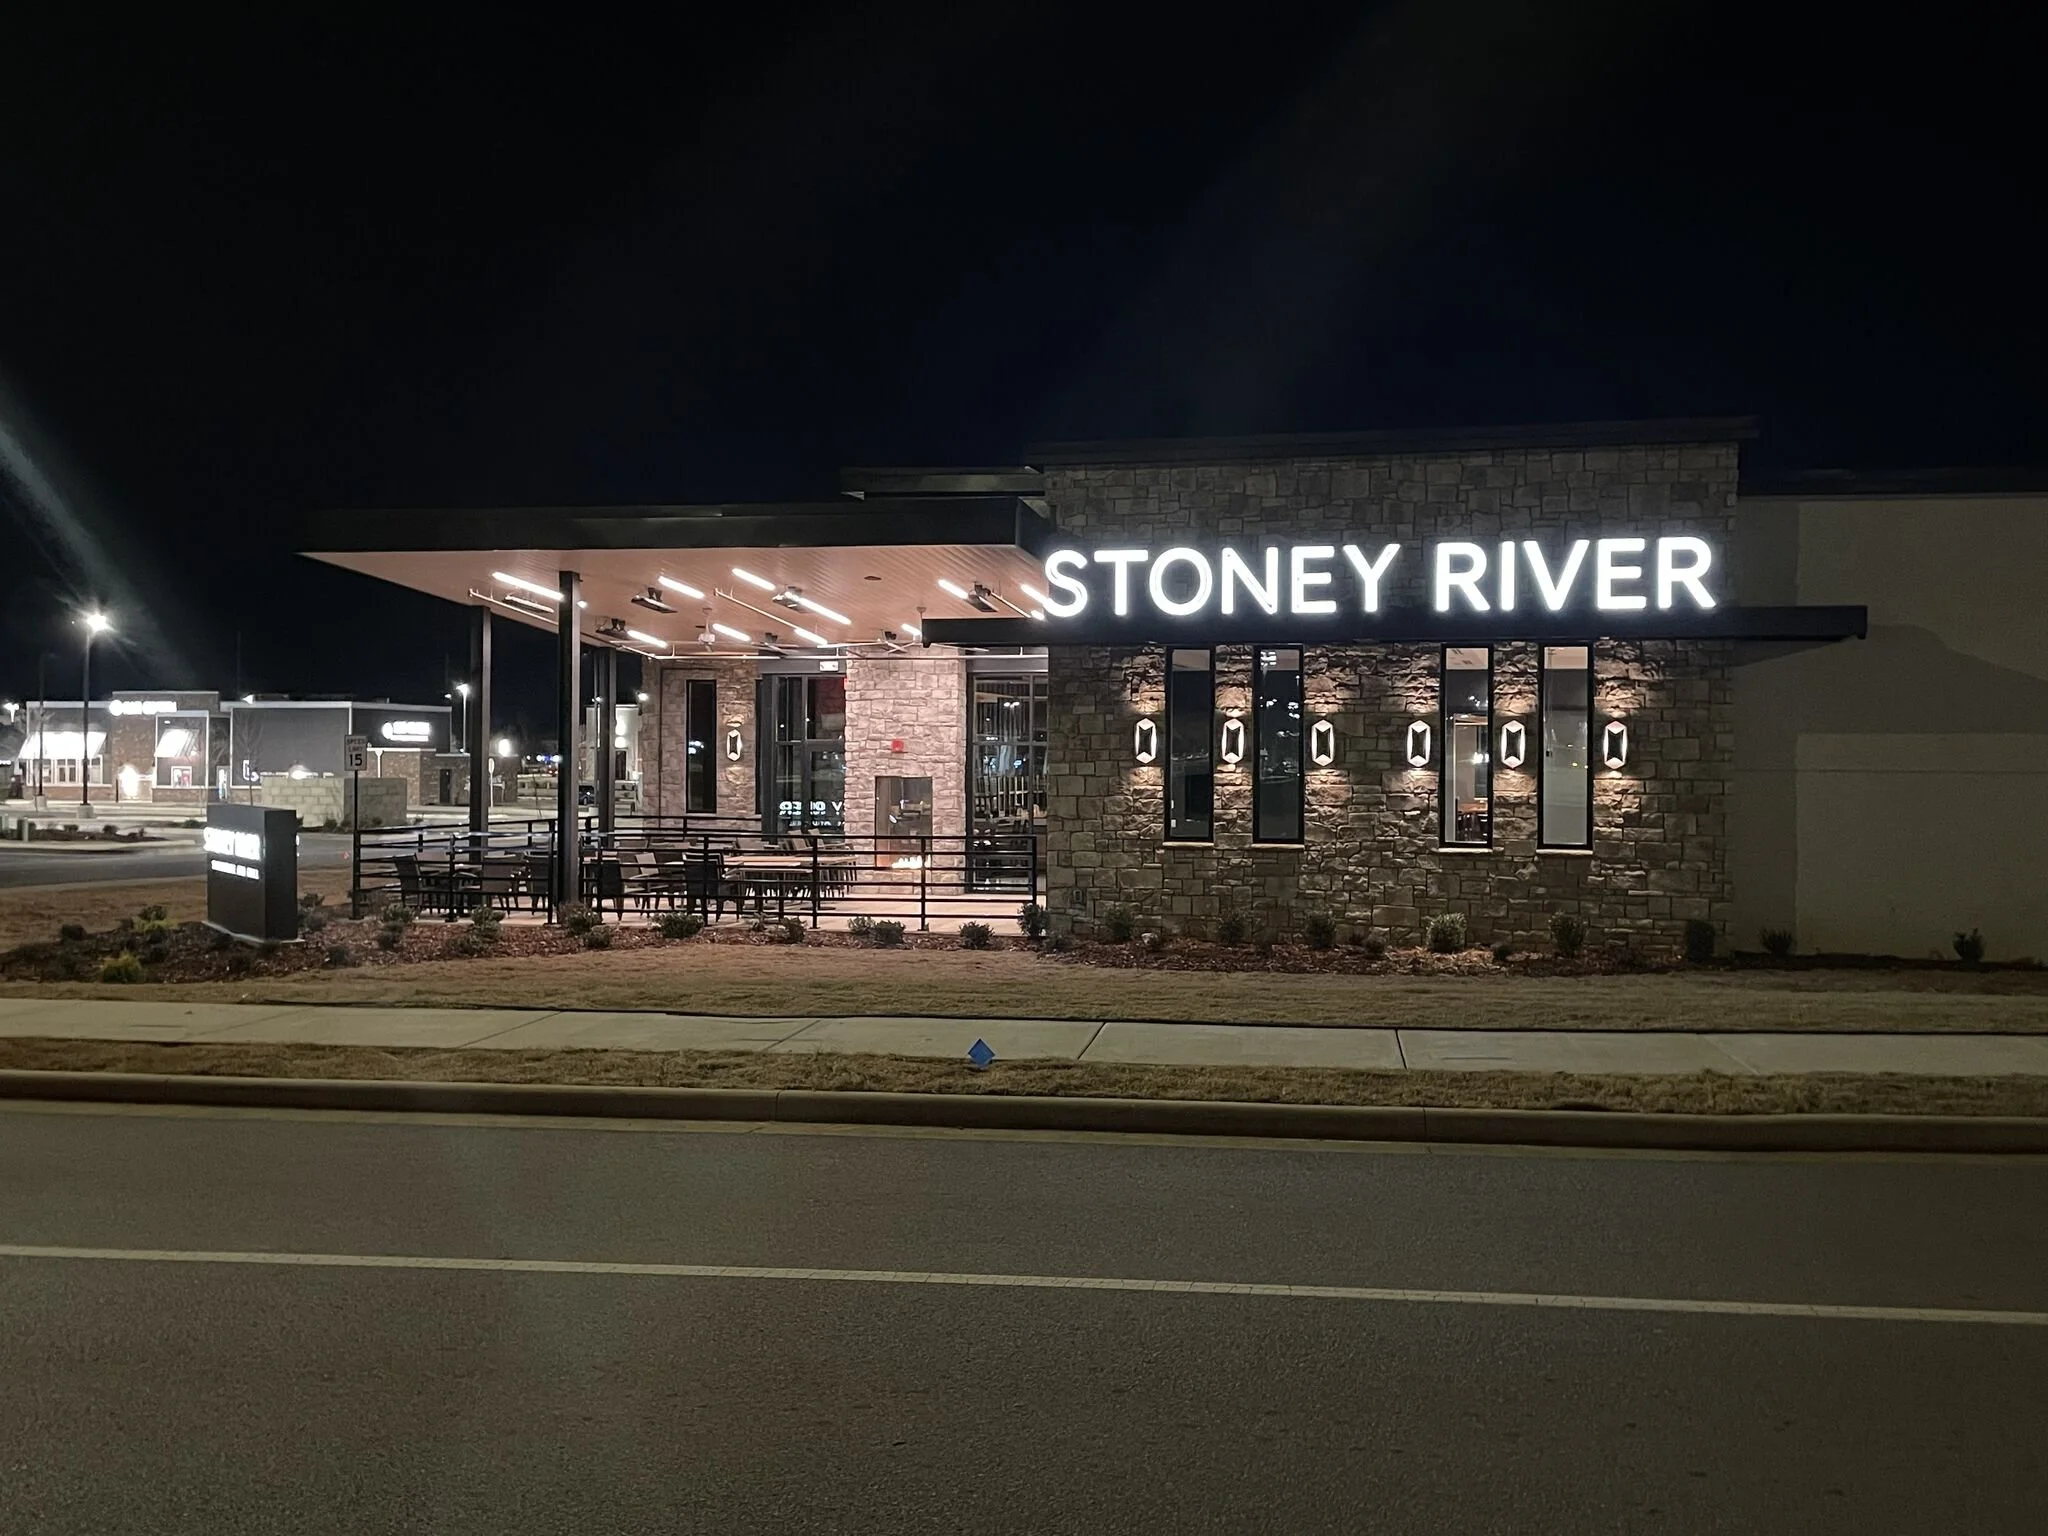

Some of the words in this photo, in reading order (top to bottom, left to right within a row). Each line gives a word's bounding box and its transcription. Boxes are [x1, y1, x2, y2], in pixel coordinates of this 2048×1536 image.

[1044, 543, 1400, 618] STONEY
[1436, 537, 1717, 612] RIVER
[350, 754, 363, 766] 15
